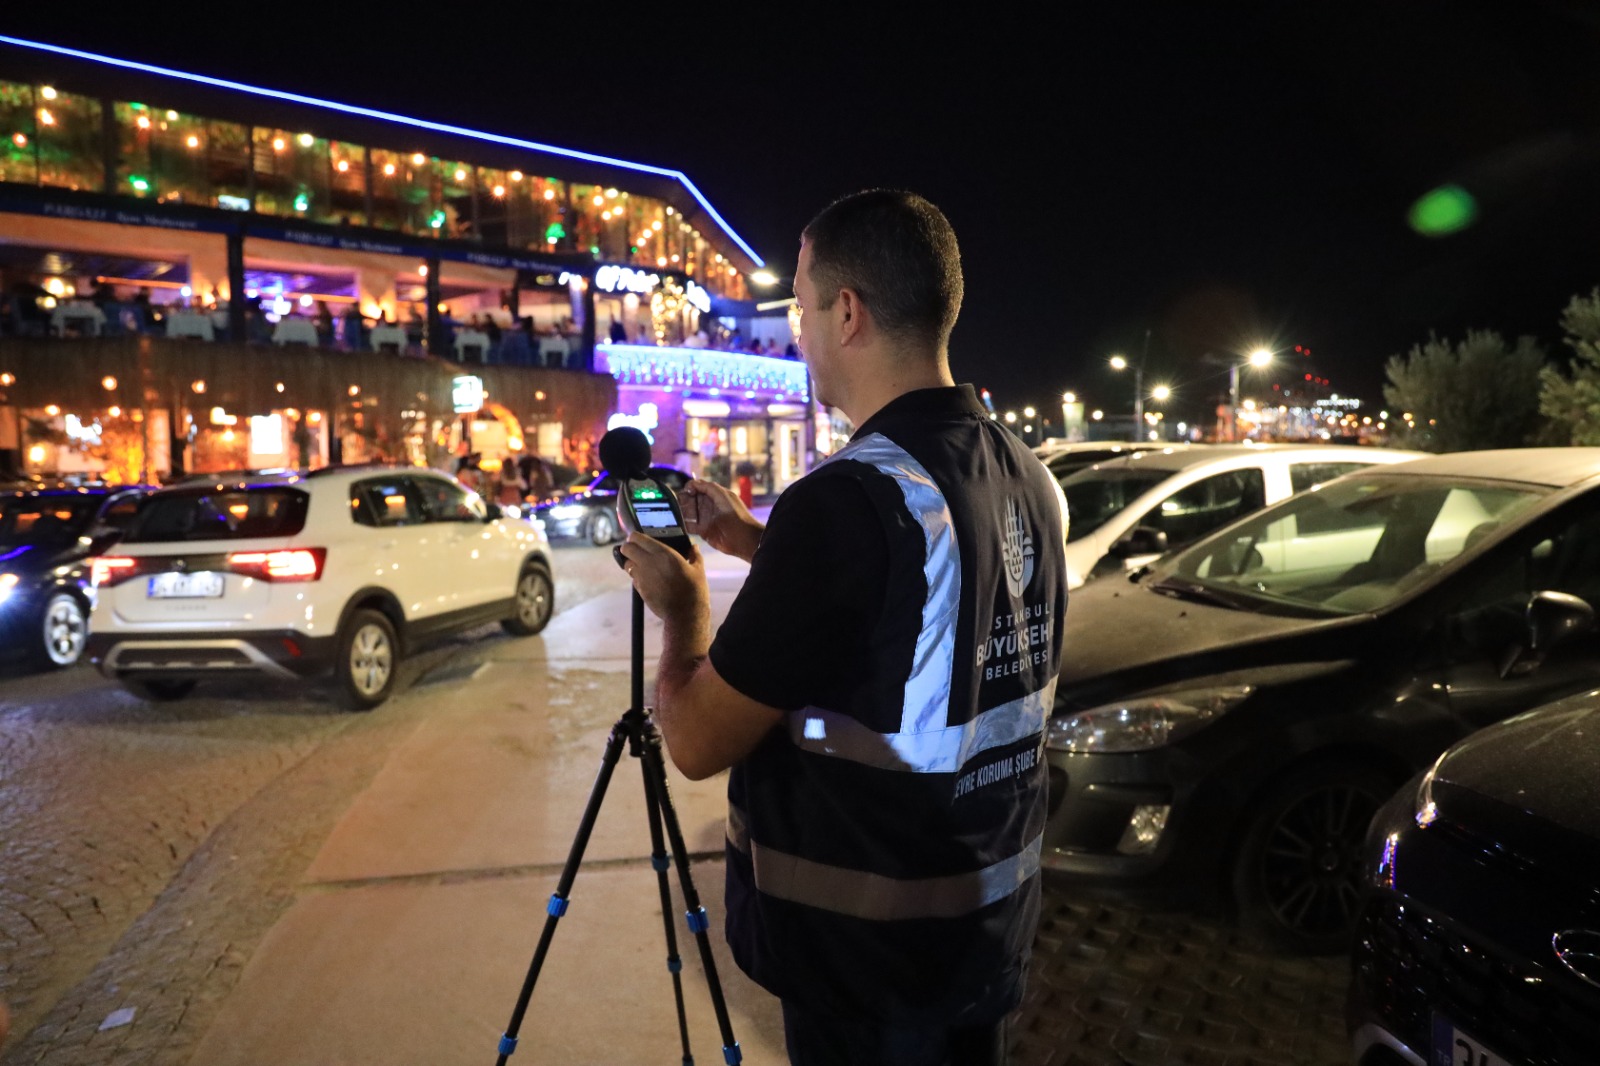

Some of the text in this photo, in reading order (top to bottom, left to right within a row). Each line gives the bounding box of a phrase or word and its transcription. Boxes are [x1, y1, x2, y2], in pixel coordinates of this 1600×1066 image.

[995, 602, 1050, 630] STANBUL
[976, 618, 1055, 667] BÜYÜKŞEH
[952, 770, 976, 800] EVRE
[976, 757, 1014, 788] KORUMA
[1015, 748, 1036, 779] ŞUBE
